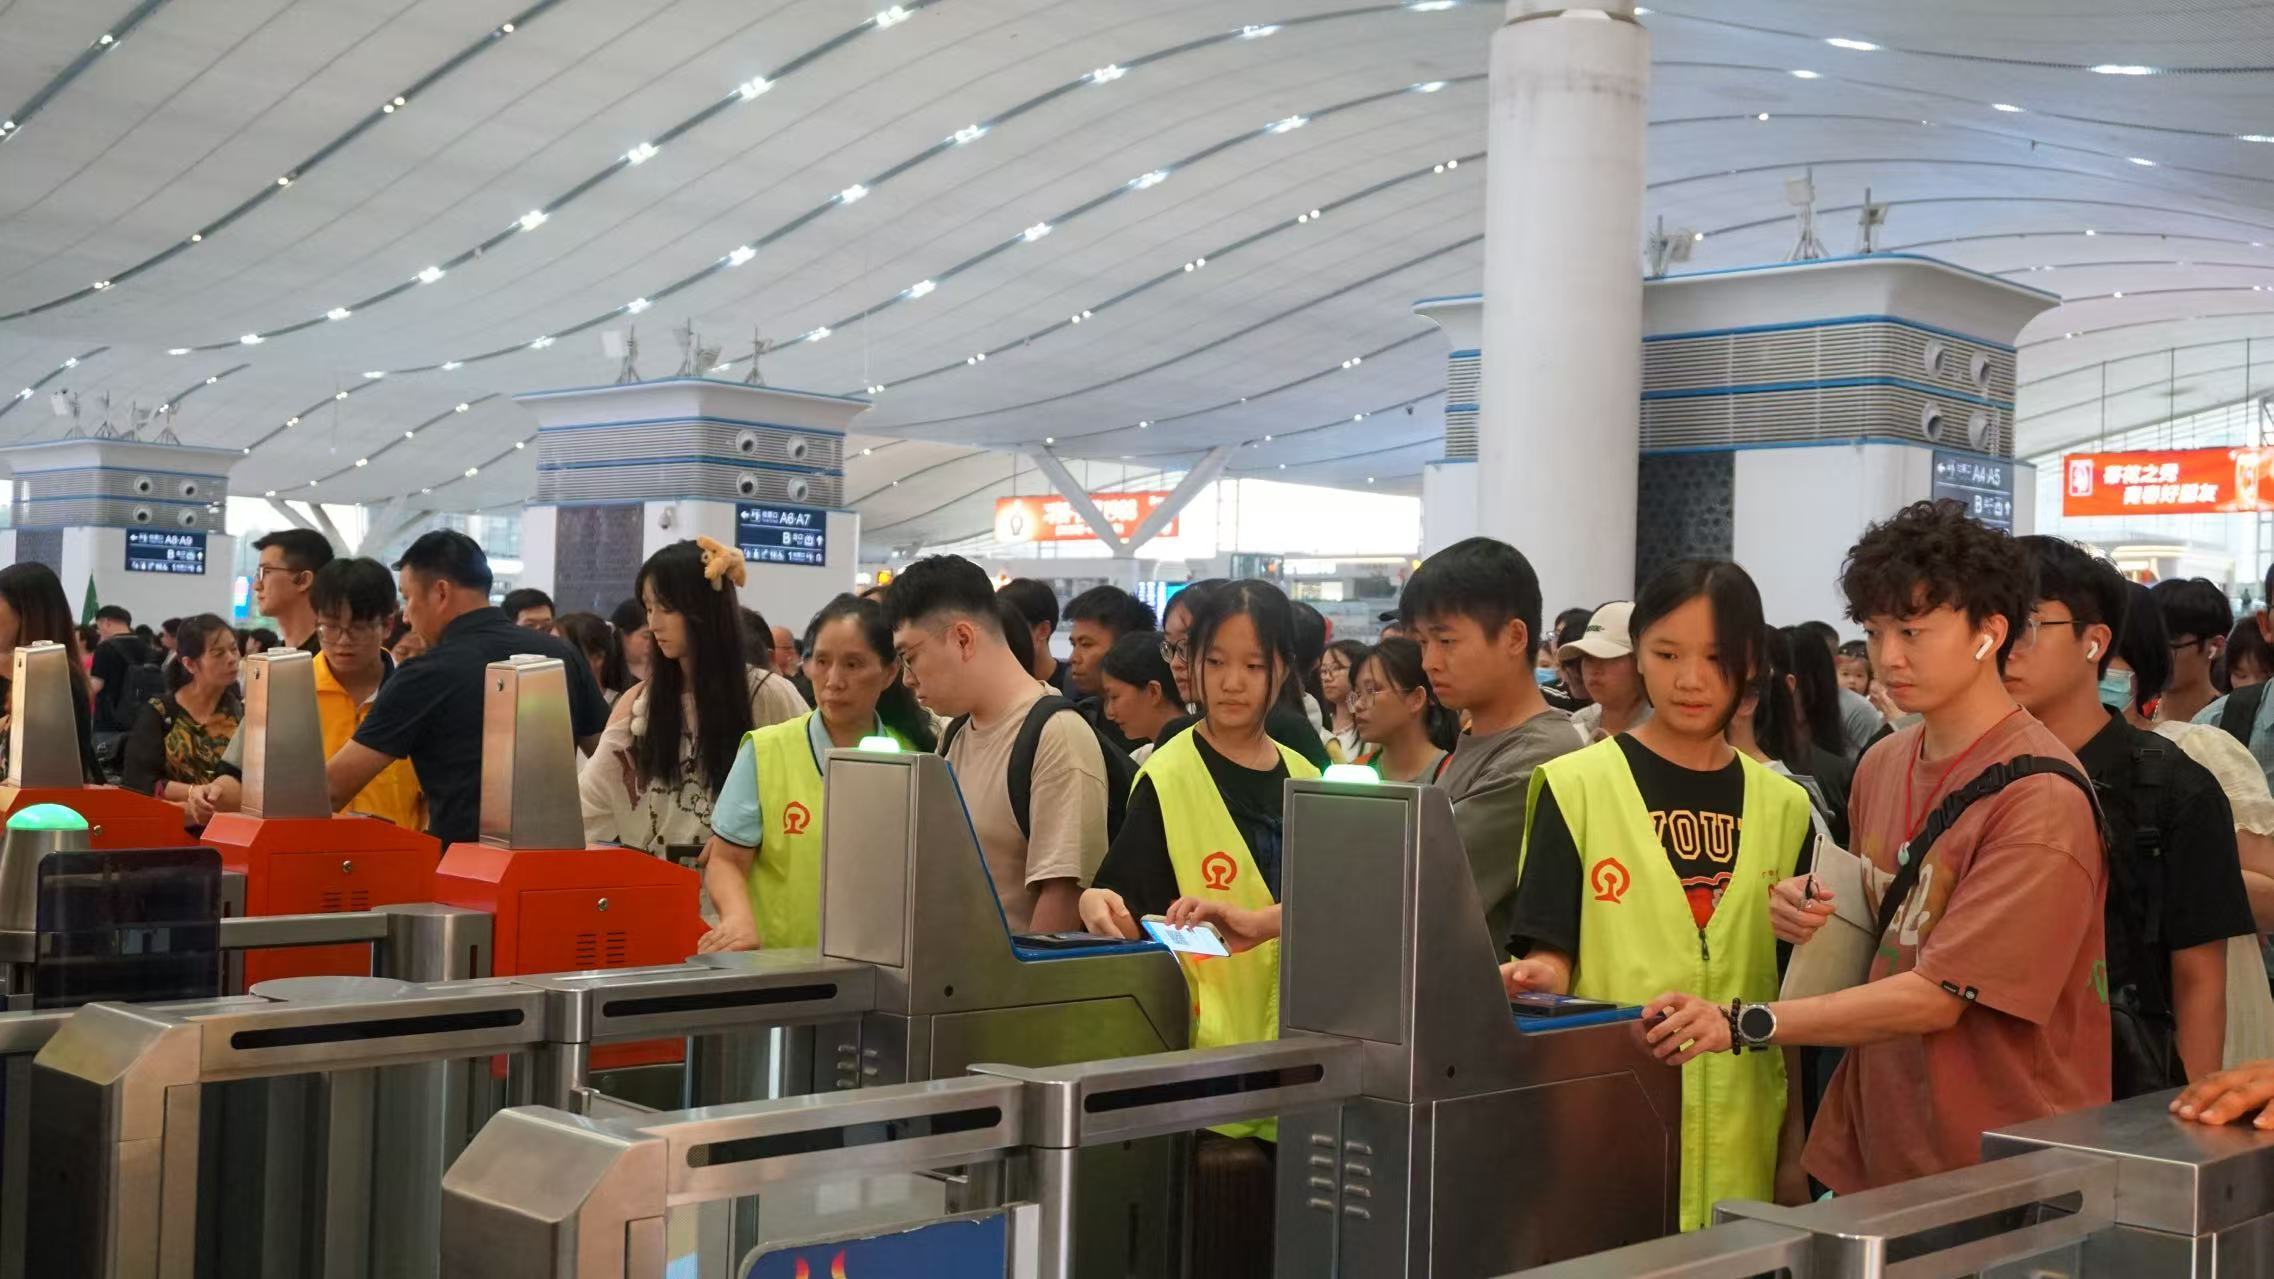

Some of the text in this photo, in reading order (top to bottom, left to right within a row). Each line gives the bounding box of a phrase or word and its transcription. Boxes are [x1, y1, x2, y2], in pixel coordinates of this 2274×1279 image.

[1974, 494, 1983, 514] B
[782, 531, 791, 545] B
[1649, 810, 1744, 863] OU
